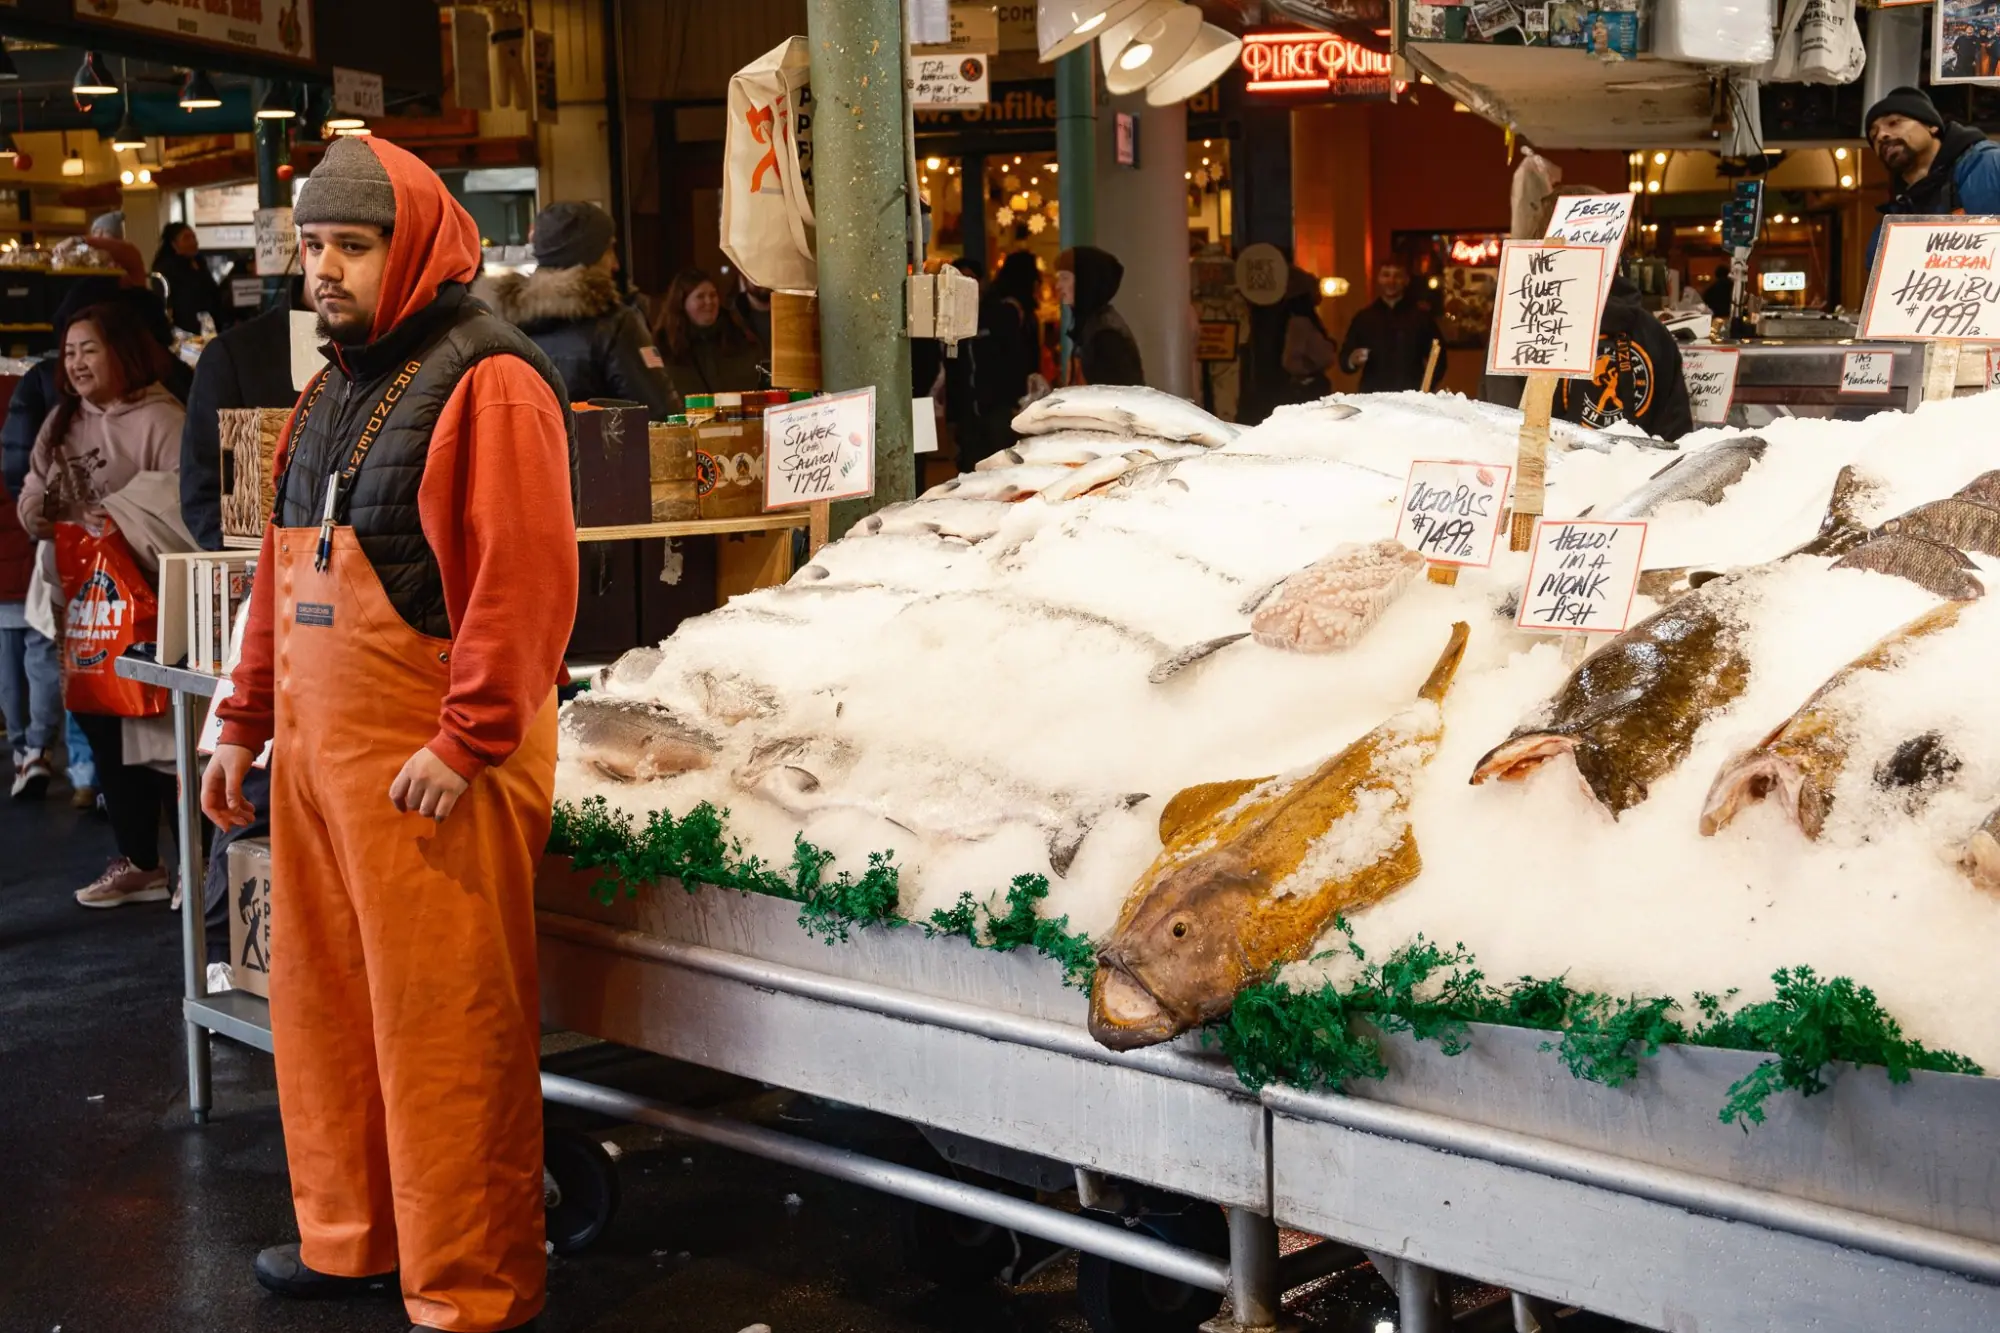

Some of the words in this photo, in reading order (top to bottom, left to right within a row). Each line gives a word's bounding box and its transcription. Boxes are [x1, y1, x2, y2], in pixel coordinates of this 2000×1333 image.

[1802, 9, 1844, 26] MARKET
[1241, 42, 1317, 81] PLACE
[1317, 40, 1391, 80] PIGALL
[1564, 198, 1621, 221] FRESH
[1552, 224, 1625, 245] AASKAN
[1925, 231, 2000, 253] WHOLE
[1528, 248, 1567, 275] WE
[1924, 247, 1996, 270] ALASKAN
[1891, 269, 2000, 306] HALIBU
[1519, 298, 1568, 323] YOUR
[783, 422, 842, 447] SILVER
[777, 441, 842, 472] SALMON
[1406, 480, 1493, 518] OCTOPUS
[1548, 525, 1619, 552] HELLO!
[1588, 553, 1613, 569] A
[1536, 569, 1611, 600] MONK
[67, 598, 127, 627] SHRT
